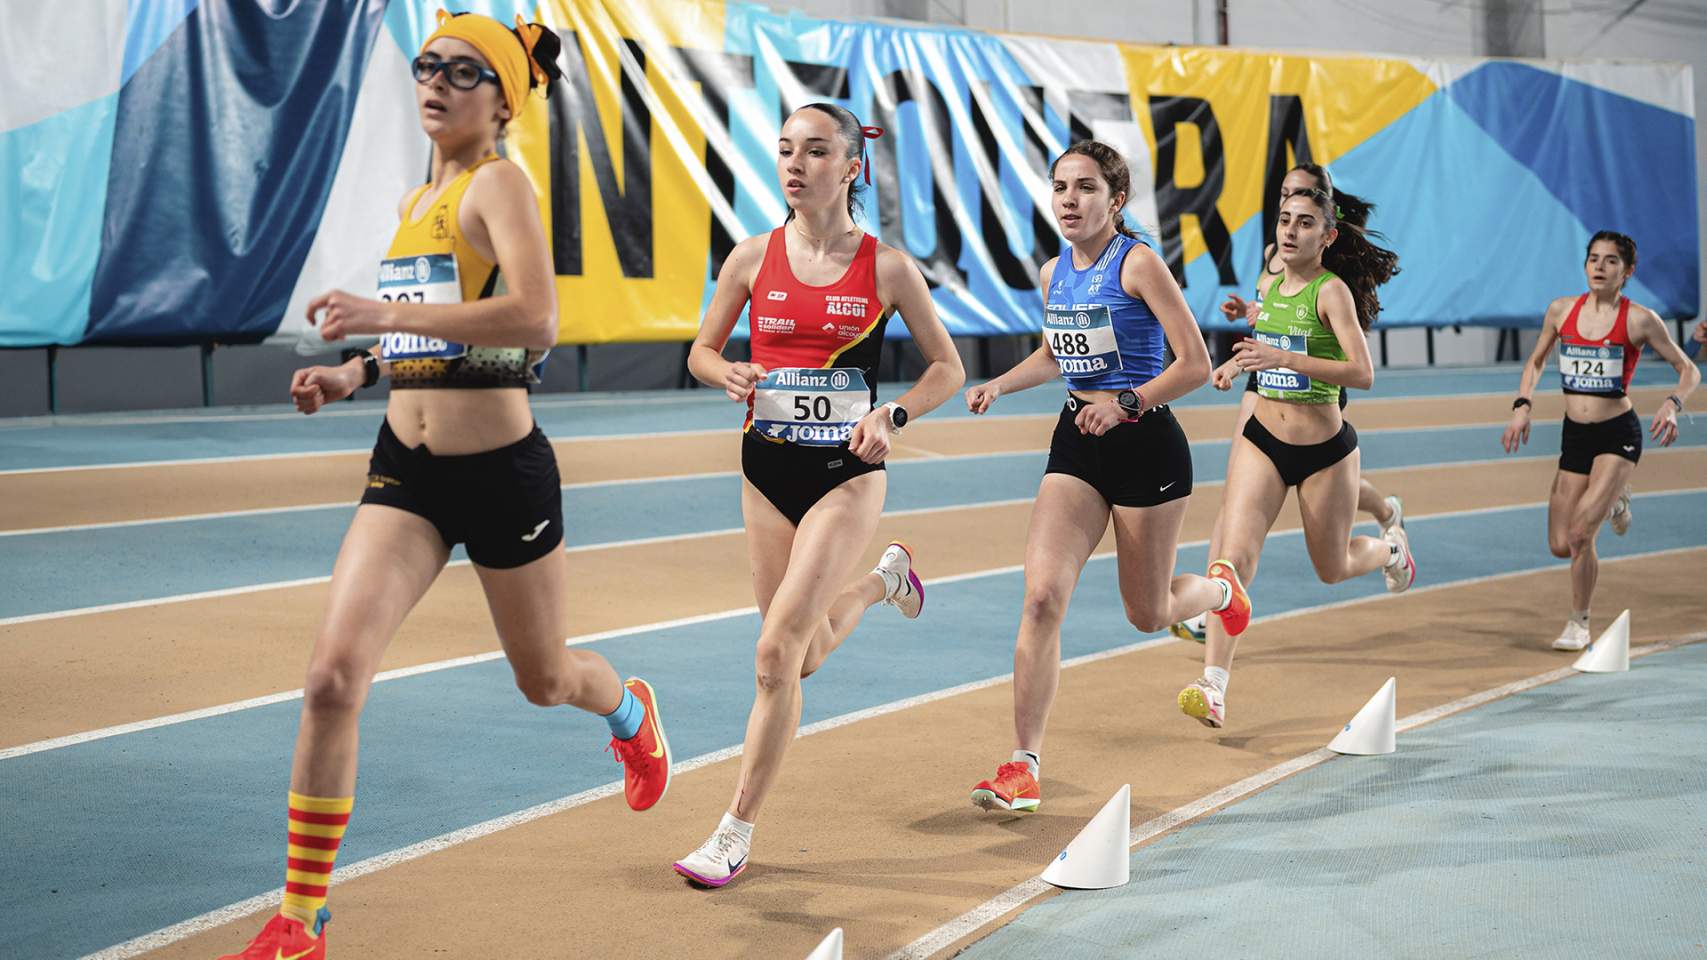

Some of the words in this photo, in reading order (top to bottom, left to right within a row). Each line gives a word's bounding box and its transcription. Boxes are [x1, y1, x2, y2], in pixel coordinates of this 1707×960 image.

[826, 302, 866, 317] ALCOI
[764, 317, 795, 326] TRAIL
[1047, 313, 1075, 326] Allianz
[1287, 325, 1313, 337] Vital
[1052, 333, 1090, 355] 488
[1566, 346, 1597, 357] Allianz
[1571, 360, 1605, 376] 124
[775, 371, 828, 387] Allianz
[794, 395, 832, 421] 50
